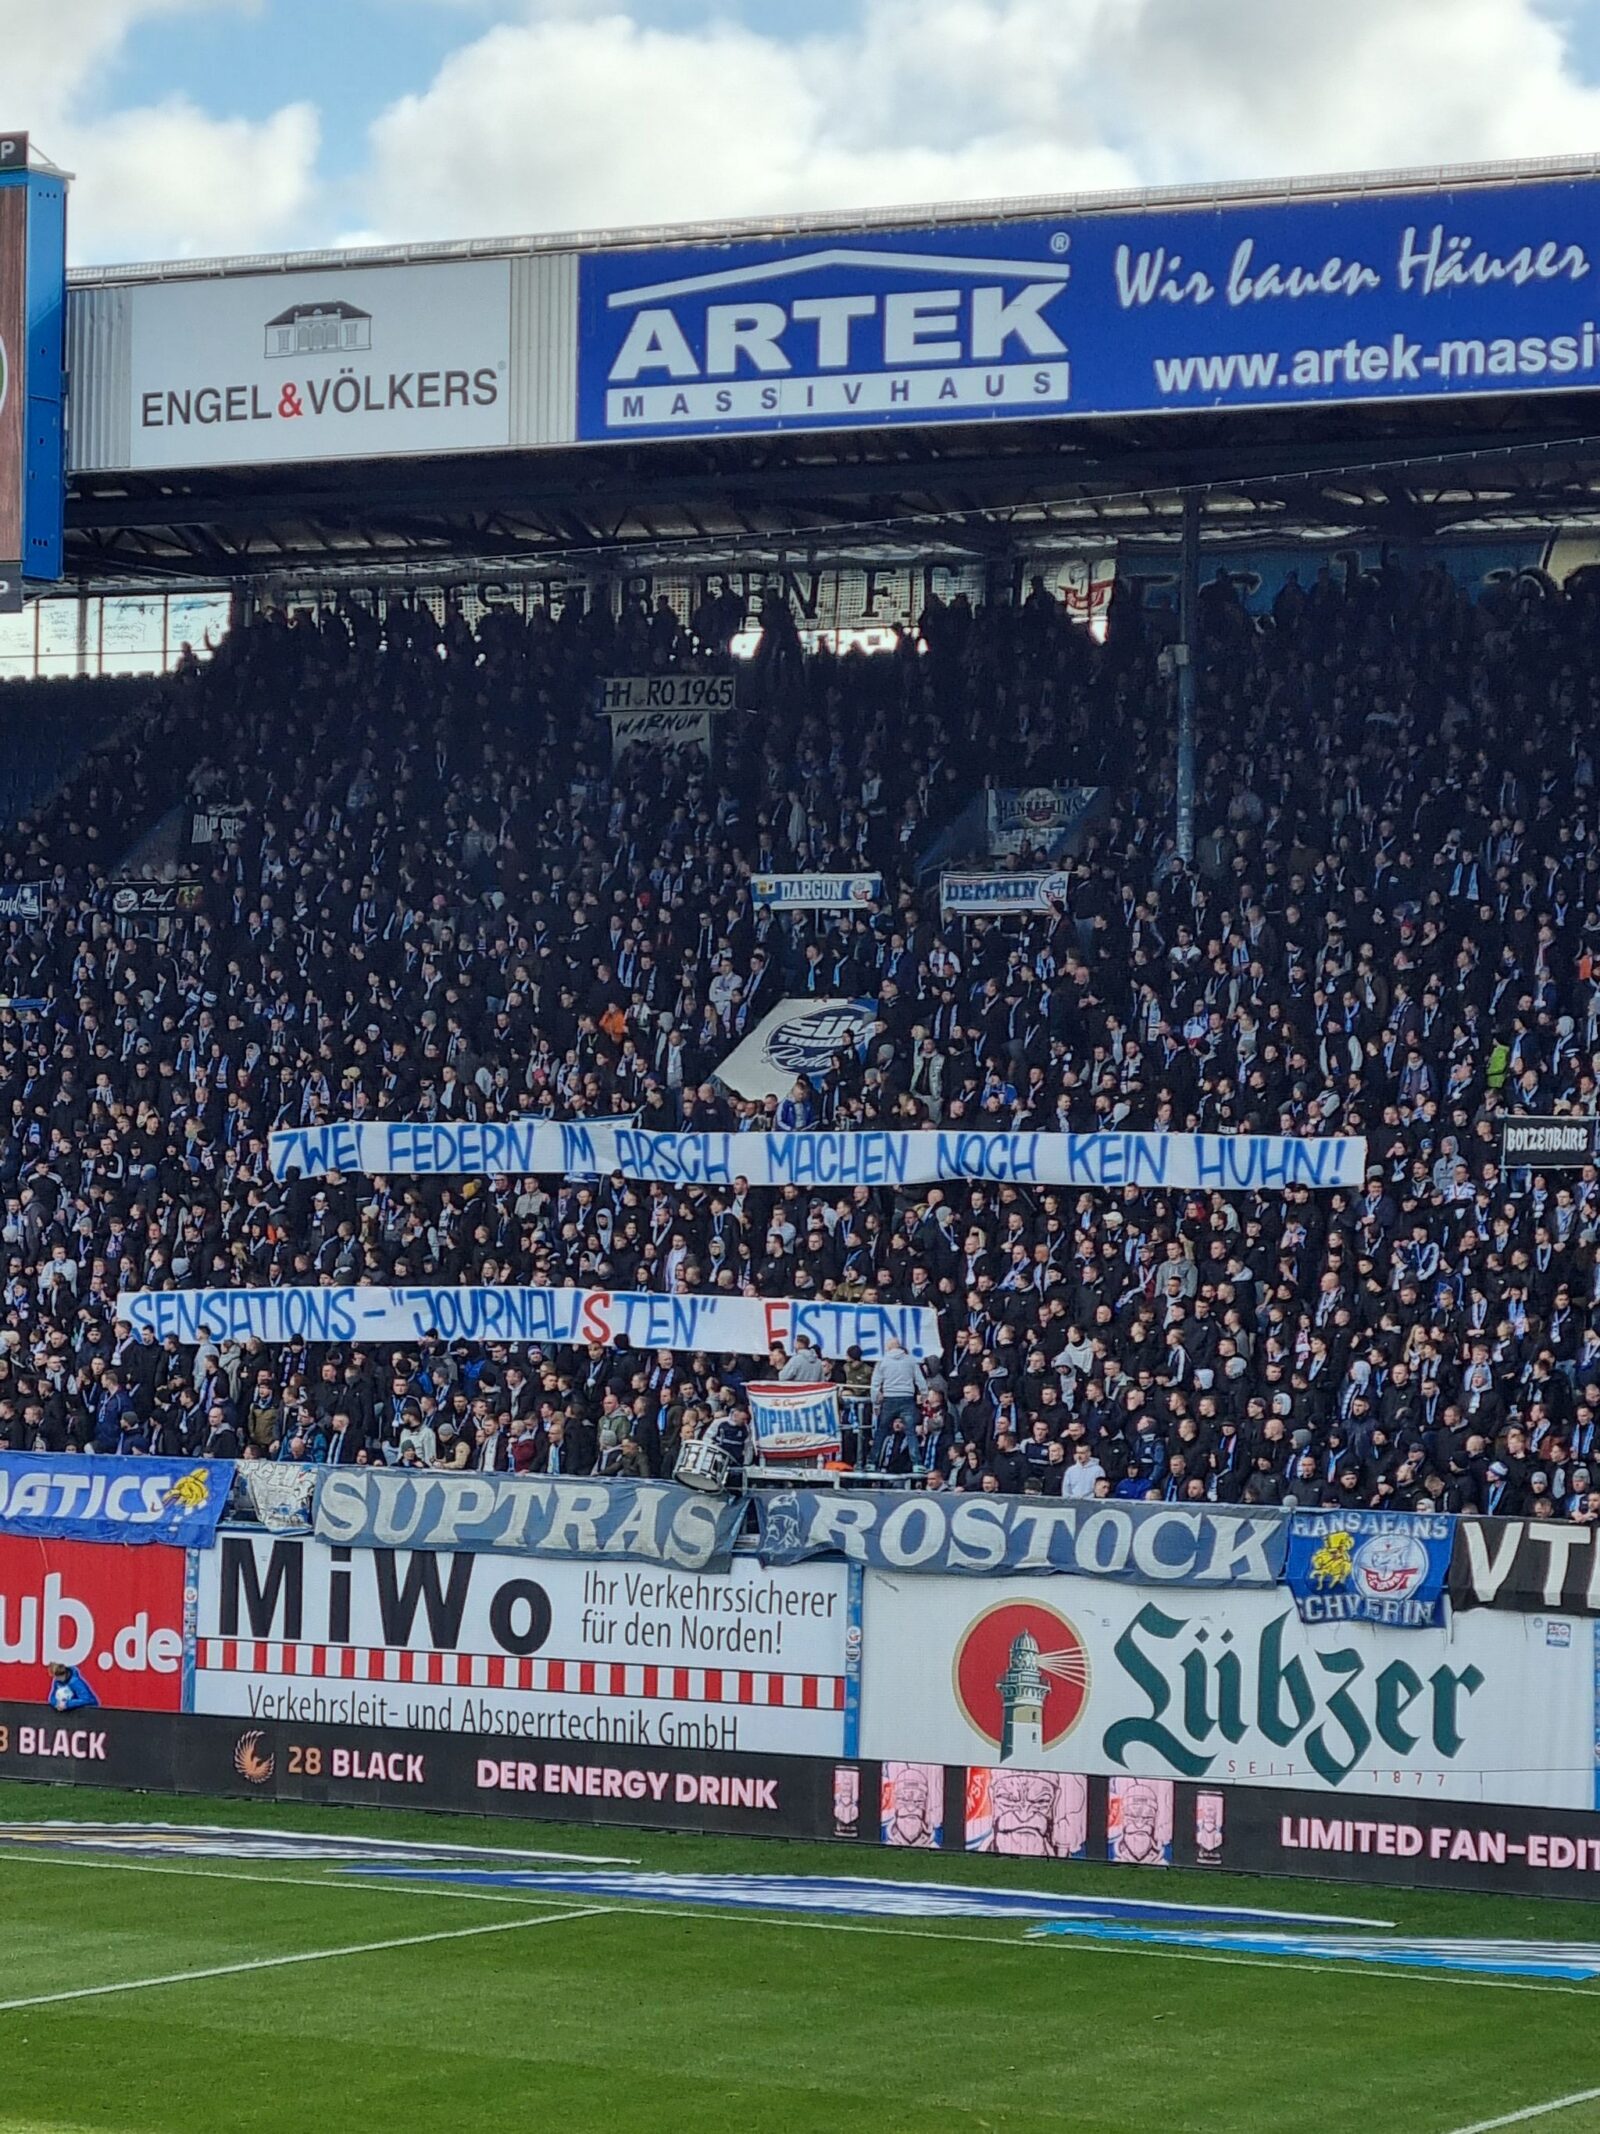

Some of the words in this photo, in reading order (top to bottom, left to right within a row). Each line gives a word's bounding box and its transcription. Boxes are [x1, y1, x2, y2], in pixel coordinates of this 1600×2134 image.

[1114, 243, 1216, 309] Wir
[1226, 238, 1381, 308] bauen
[1398, 224, 1591, 296] Häuser
[607, 281, 1069, 382] ARTEK
[621, 371, 1053, 418] MASSIVHAUS
[679, 679, 735, 706] 1965
[780, 880, 845, 901] DARGUN
[945, 880, 1039, 902] DEMMIN
[388, 1121, 535, 1172] FEDERN
[560, 1123, 597, 1172] IM
[614, 1129, 731, 1181] ARSCH
[765, 1131, 909, 1184] MACHEN
[936, 1132, 1041, 1180] NOCH
[1066, 1134, 1169, 1187] KEIN
[1199, 1136, 1348, 1188] HUHN!
[0, 1469, 171, 1523] ATICS
[316, 1471, 726, 1569] SUPTRAS
[806, 1494, 1283, 1582] ROSTOCK
[218, 1537, 553, 1656] MiWo
[583, 1570, 619, 1606] Ihr
[624, 1572, 838, 1618] Verkehrssicherer
[581, 1608, 618, 1645] für
[624, 1611, 672, 1649] den
[680, 1614, 783, 1655] Norden!
[246, 1684, 399, 1727] Verkehrsleit-
[406, 1698, 452, 1732] und
[459, 1698, 650, 1746] Absperrtechnik
[658, 1710, 738, 1750] GmbH
[1101, 1601, 1486, 1788] Lübzer
[18, 1726, 107, 1760] BLACK
[287, 1745, 323, 1776] 28
[331, 1749, 425, 1784] BLACK
[476, 1758, 538, 1792] DER
[543, 1763, 670, 1801] ENERGY
[675, 1773, 779, 1810] DRINK
[1227, 1759, 1295, 1777] SEIT
[1372, 1770, 1446, 1787] 1877
[1280, 1816, 1424, 1857] LIMITED
